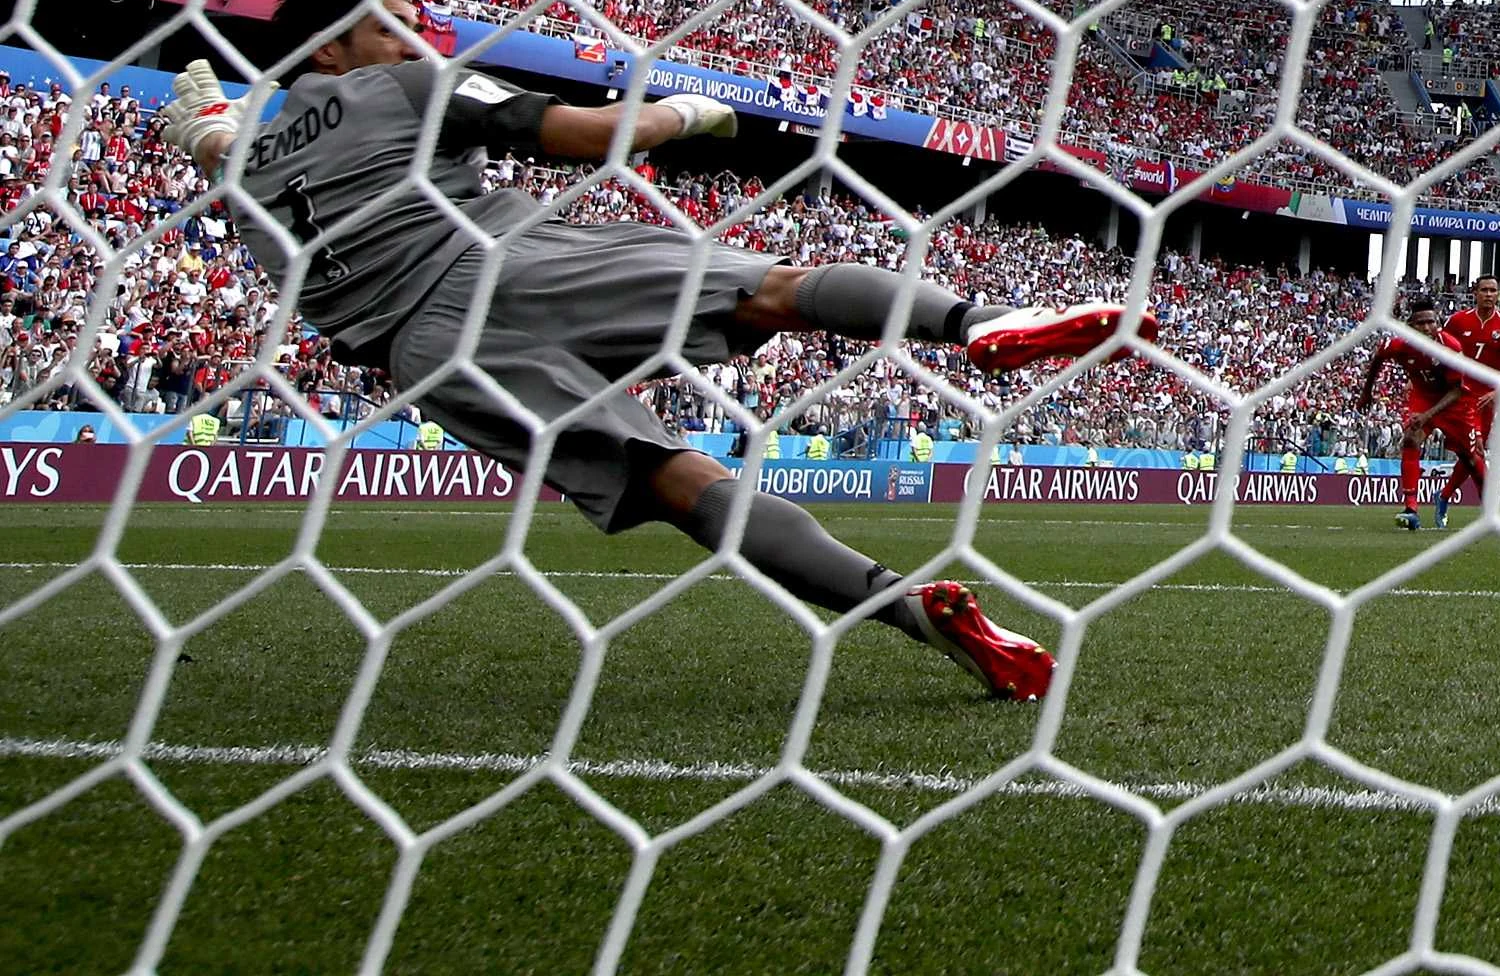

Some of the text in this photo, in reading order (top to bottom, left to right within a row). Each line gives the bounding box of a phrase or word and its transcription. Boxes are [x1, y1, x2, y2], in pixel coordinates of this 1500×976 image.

[675, 73, 703, 93] FIFA
[706, 79, 754, 103] WORLD
[1429, 214, 1464, 230] МИРА
[1467, 219, 1485, 232] ПО
[1475, 342, 1485, 359] 7
[0, 447, 63, 498] YS
[167, 448, 516, 503] QATAR AIRWAYS
[757, 468, 872, 498] НОВГОРОД
[899, 476, 925, 485] RUSSIA
[1048, 469, 1139, 501] AIRWAYS
[1244, 474, 1318, 503] AIRWAYS
[1348, 475, 1400, 506] QATAR
